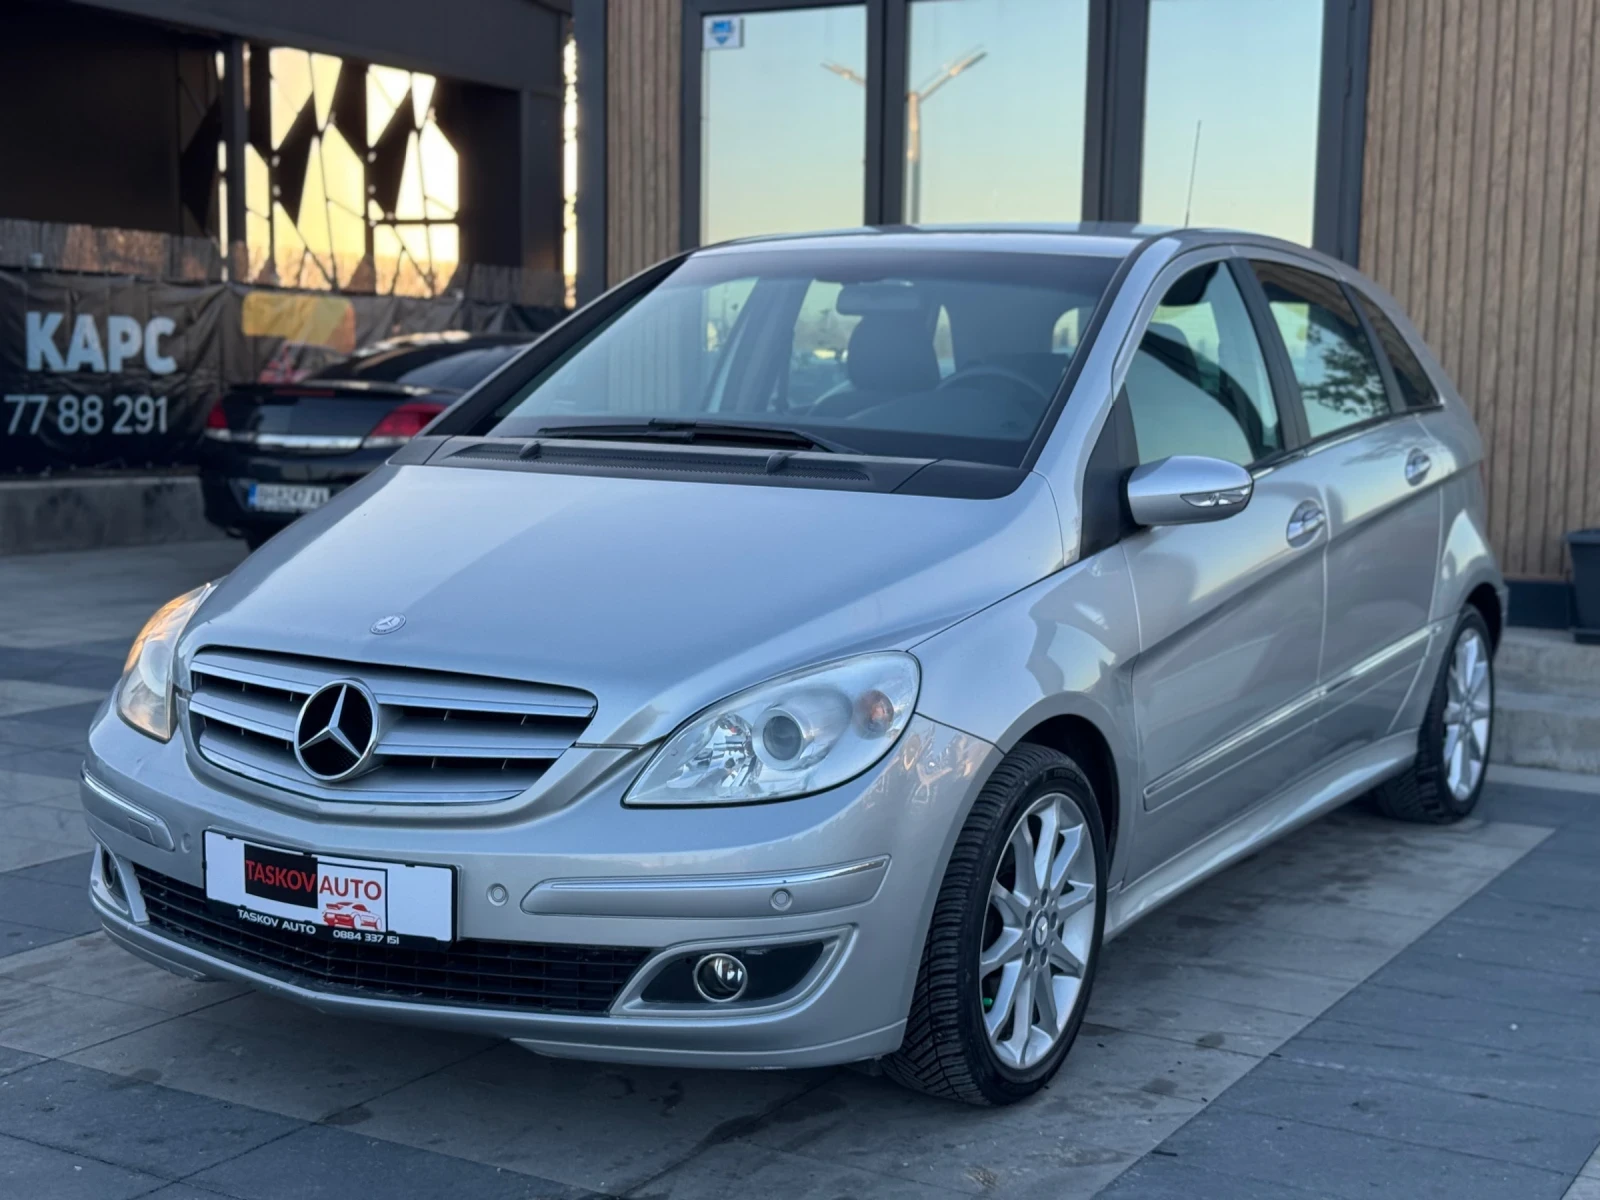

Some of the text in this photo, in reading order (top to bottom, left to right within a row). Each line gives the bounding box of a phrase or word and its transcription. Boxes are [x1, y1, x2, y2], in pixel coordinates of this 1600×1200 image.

[4, 394, 169, 436] 77 88 291
[245, 859, 382, 901] TASKOV AUTO
[237, 909, 400, 945] TASKOV AUTO 0884 337 151
